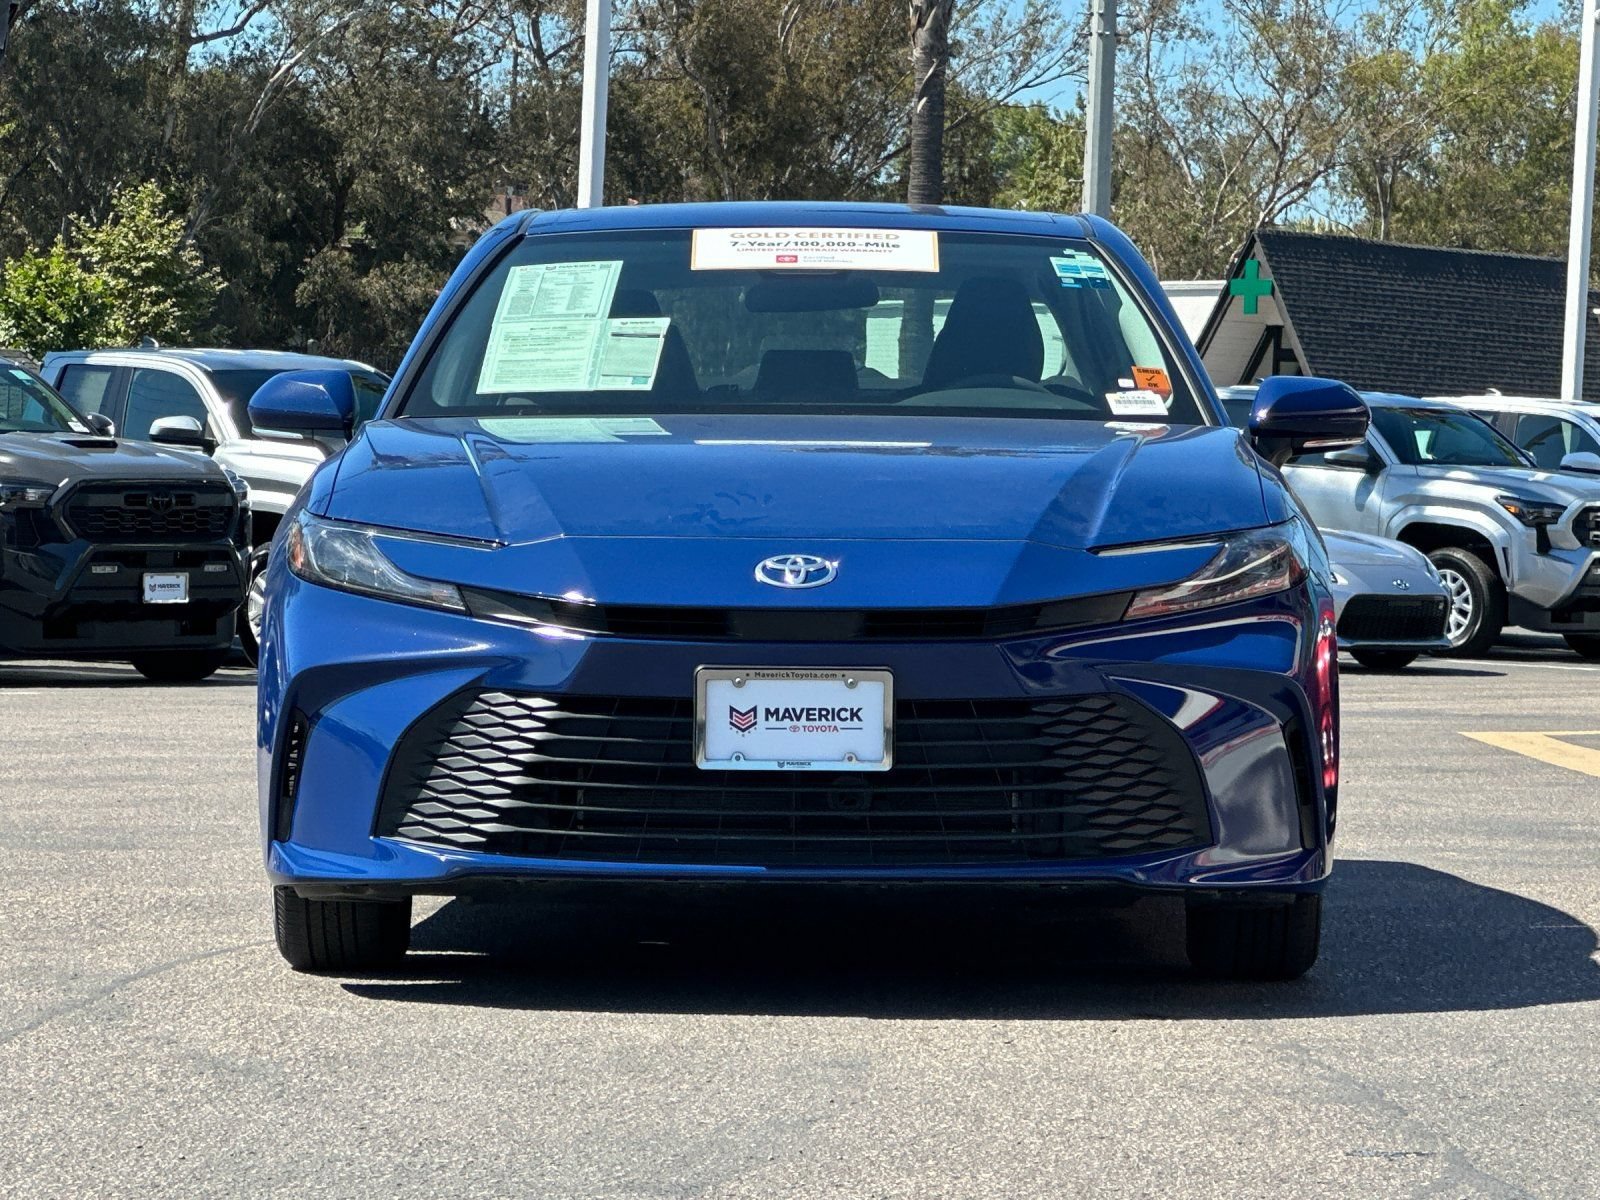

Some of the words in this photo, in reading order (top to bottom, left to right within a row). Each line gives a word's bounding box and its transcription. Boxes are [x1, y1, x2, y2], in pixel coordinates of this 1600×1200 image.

[794, 232, 900, 240] CERTIFIED
[730, 241, 901, 249] 7-Year/100,000-Mile
[764, 707, 863, 722] MAVERICK
